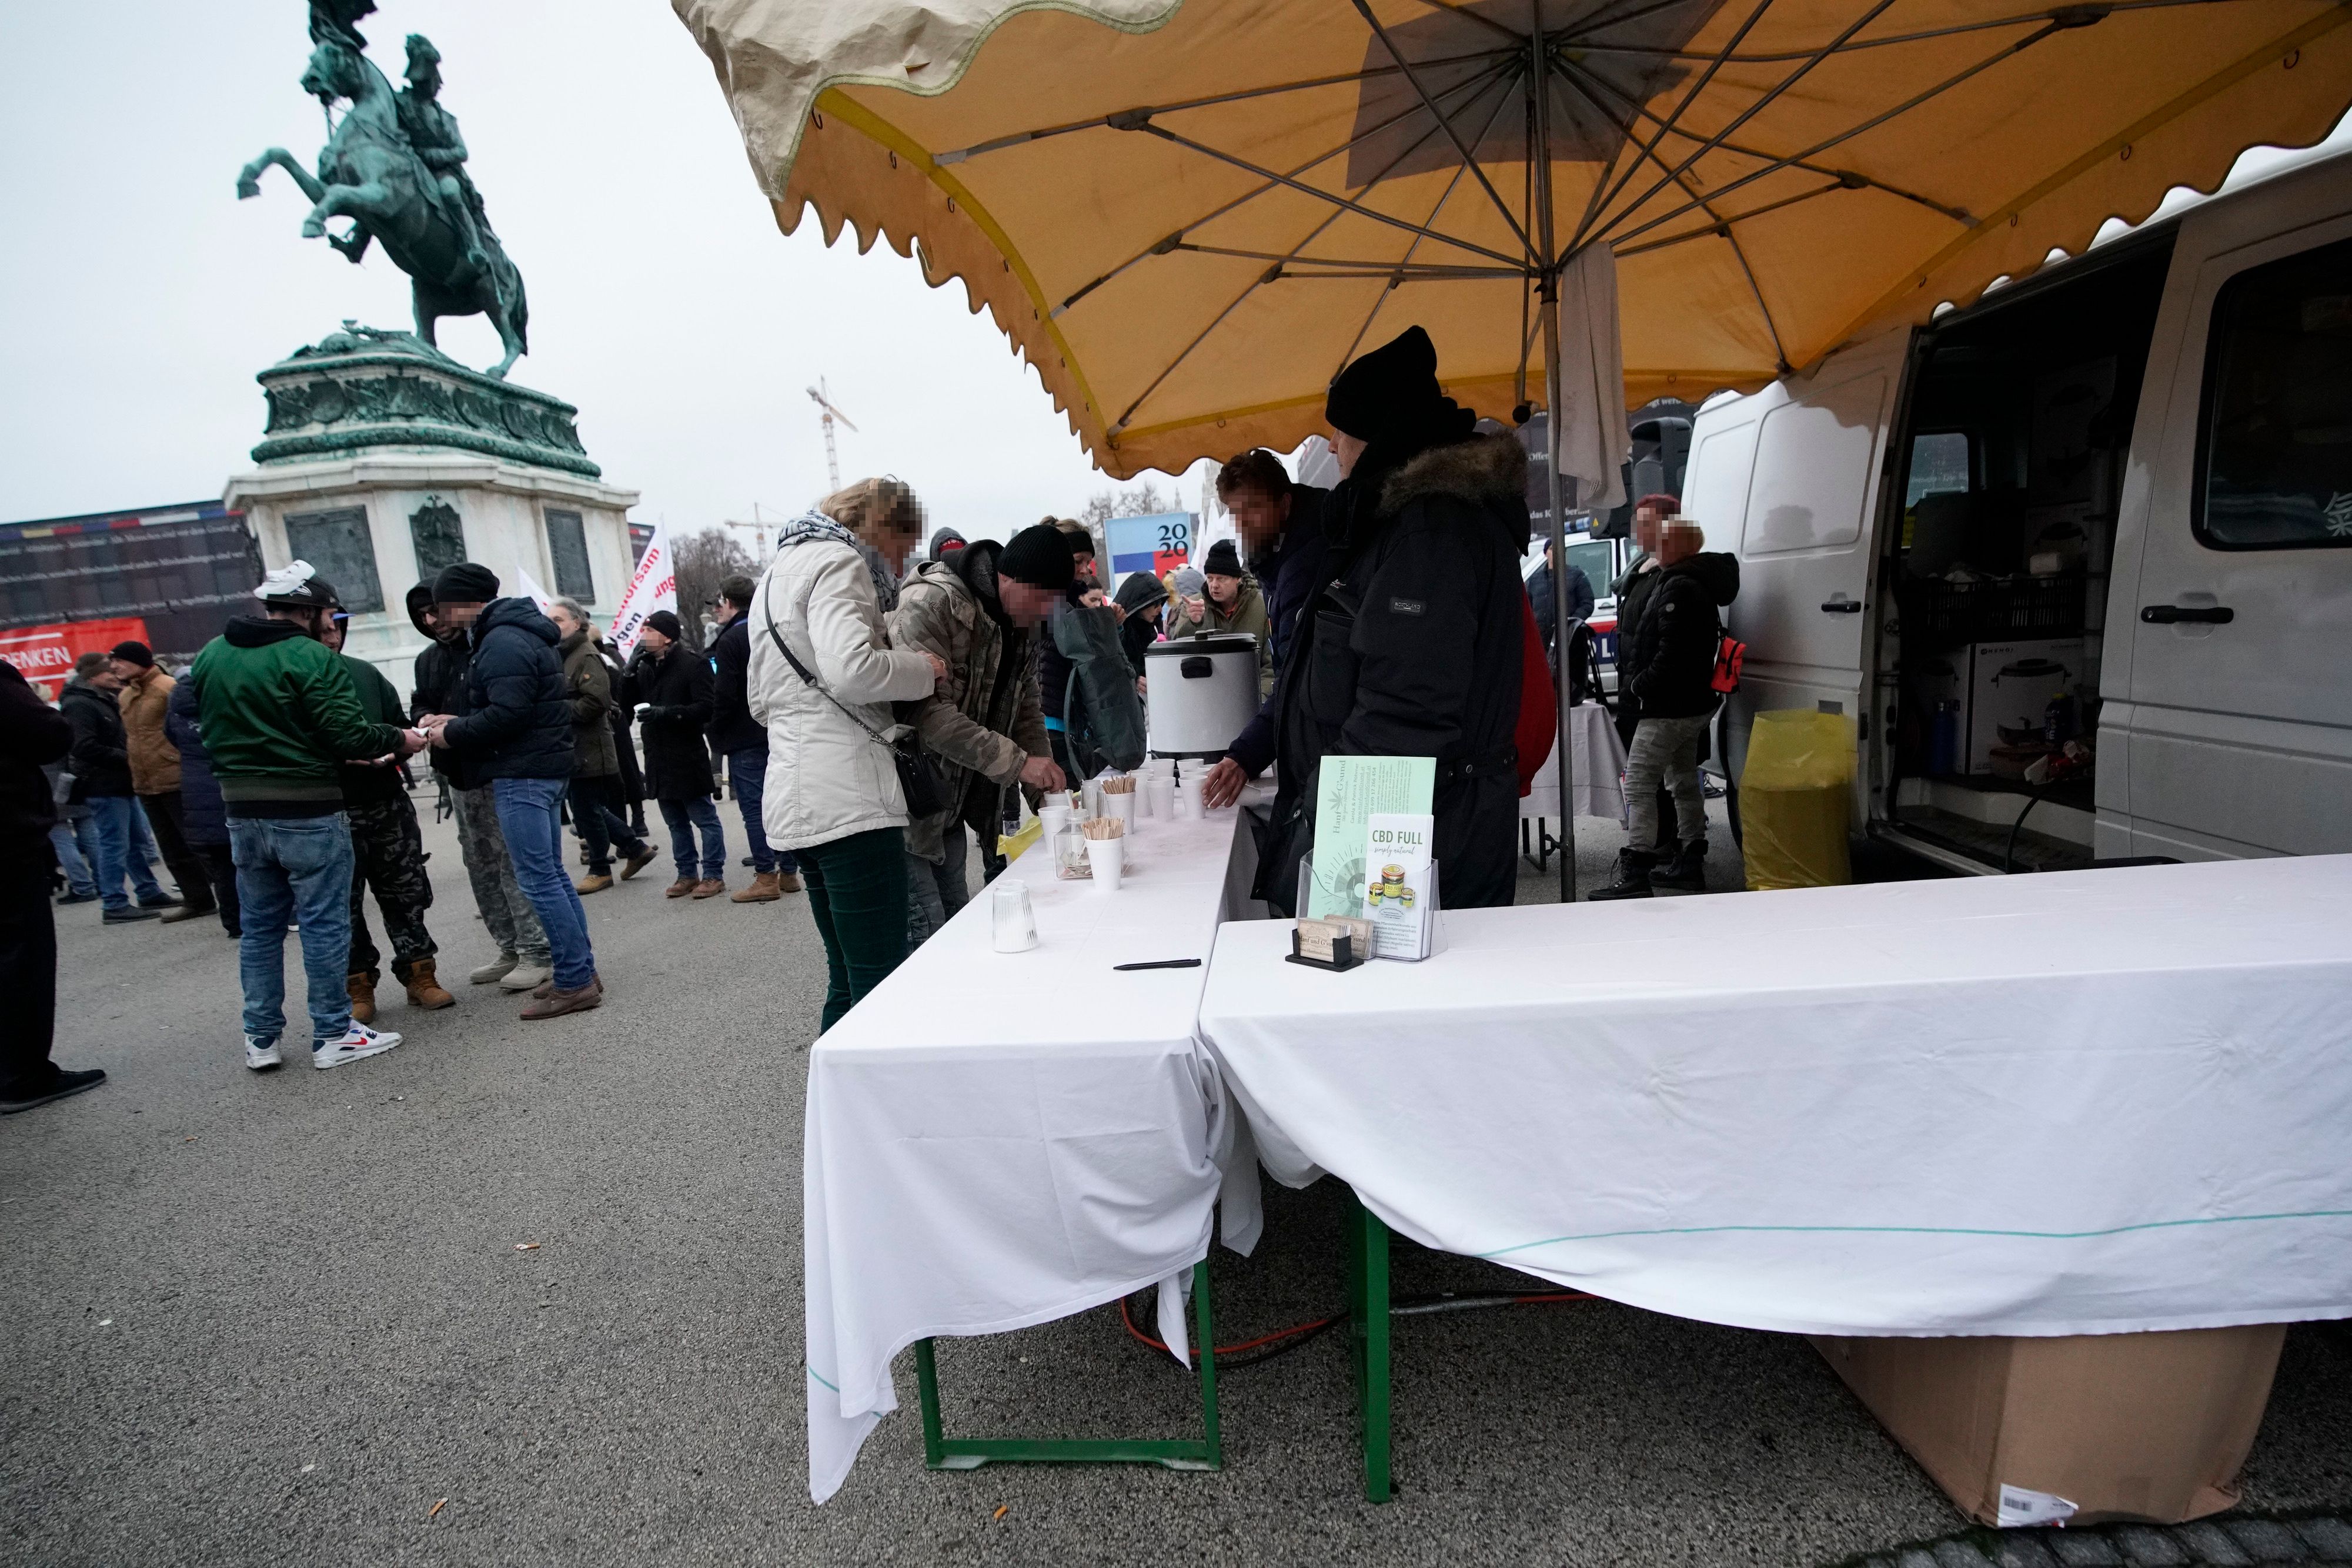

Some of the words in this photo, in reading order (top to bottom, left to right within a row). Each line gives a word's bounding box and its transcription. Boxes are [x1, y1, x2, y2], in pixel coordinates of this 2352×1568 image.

[1158, 523, 1187, 541] 20
[1159, 540, 1188, 558] 20
[1332, 811, 1342, 834] Hanf
[1372, 830, 1393, 842] CBD
[1398, 831, 1423, 844] FULL
[1374, 845, 1392, 857] simply
[1394, 846, 1415, 855] natural
